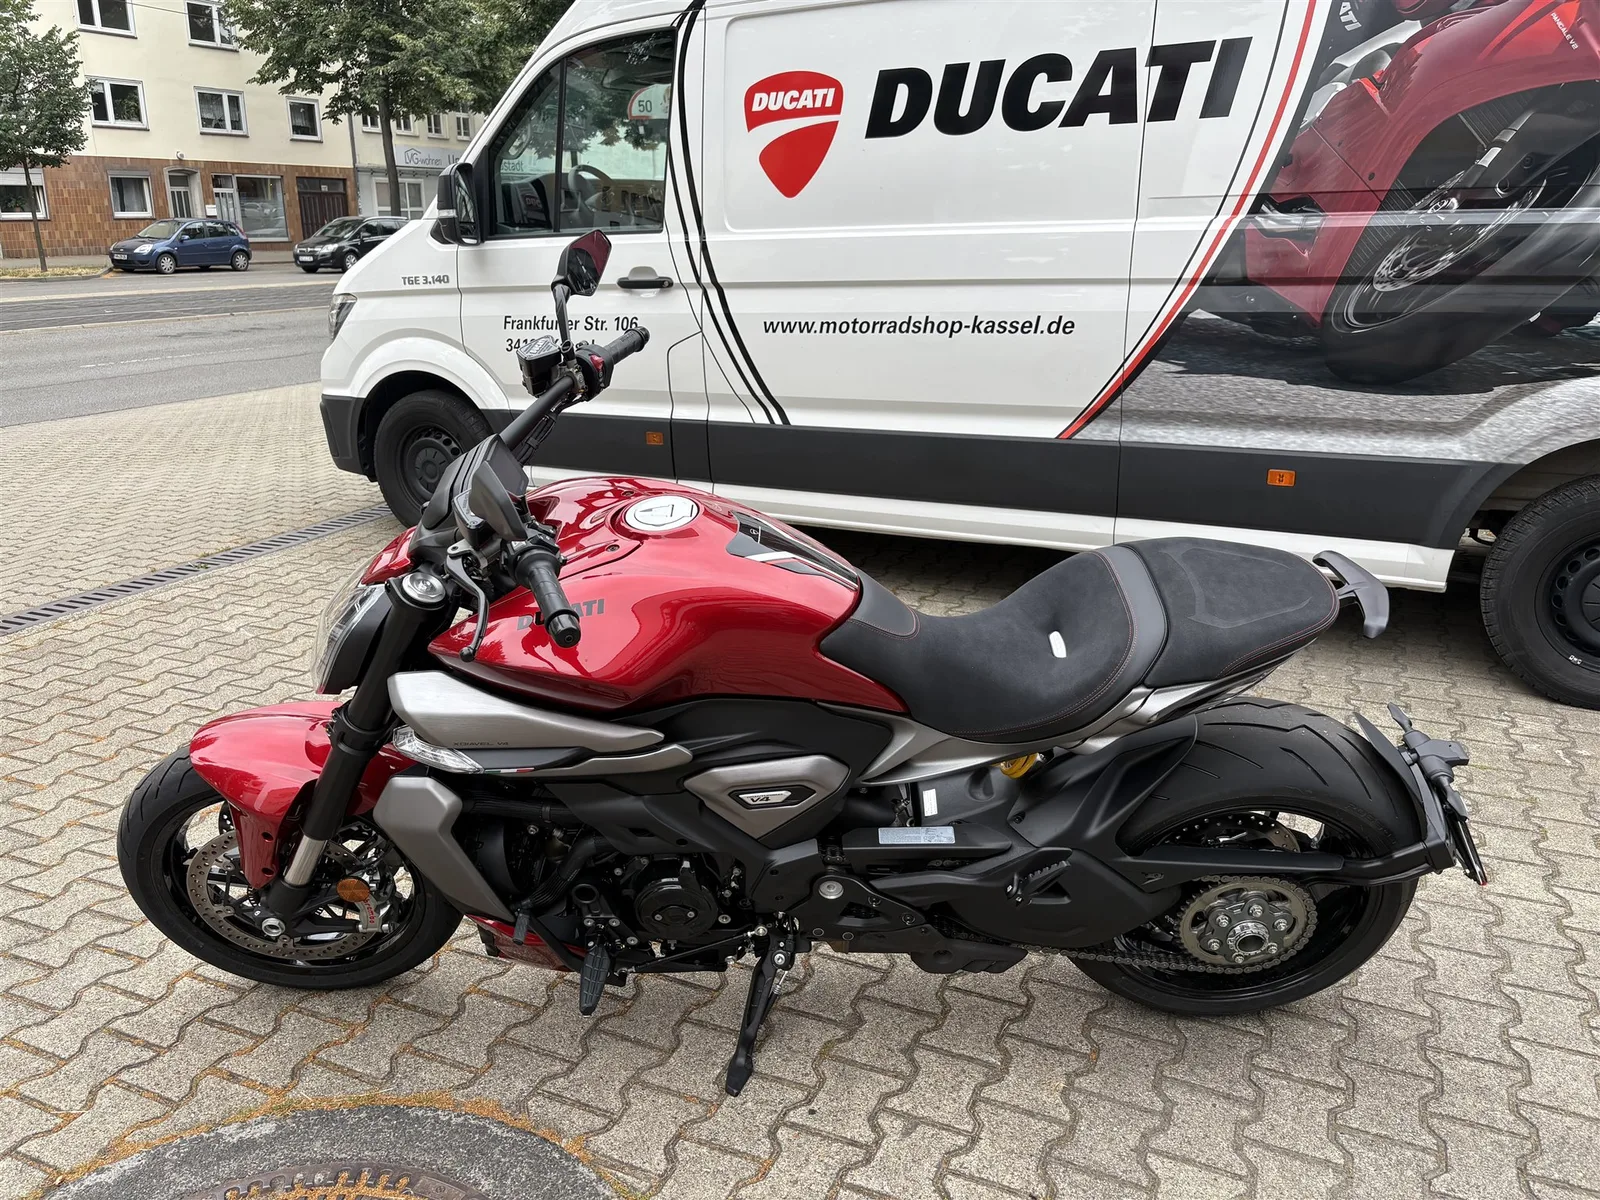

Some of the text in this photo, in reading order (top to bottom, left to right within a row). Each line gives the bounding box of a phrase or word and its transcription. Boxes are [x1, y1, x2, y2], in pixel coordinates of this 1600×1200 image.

[864, 36, 1252, 140] DUCATI
[638, 99, 653, 113] 50
[751, 87, 835, 112] DUCATI
[401, 274, 450, 286] TGE 3.140
[584, 316, 608, 331] Str.
[614, 316, 639, 331] 106
[763, 315, 1076, 338] www.motorradshop-kassel.de
